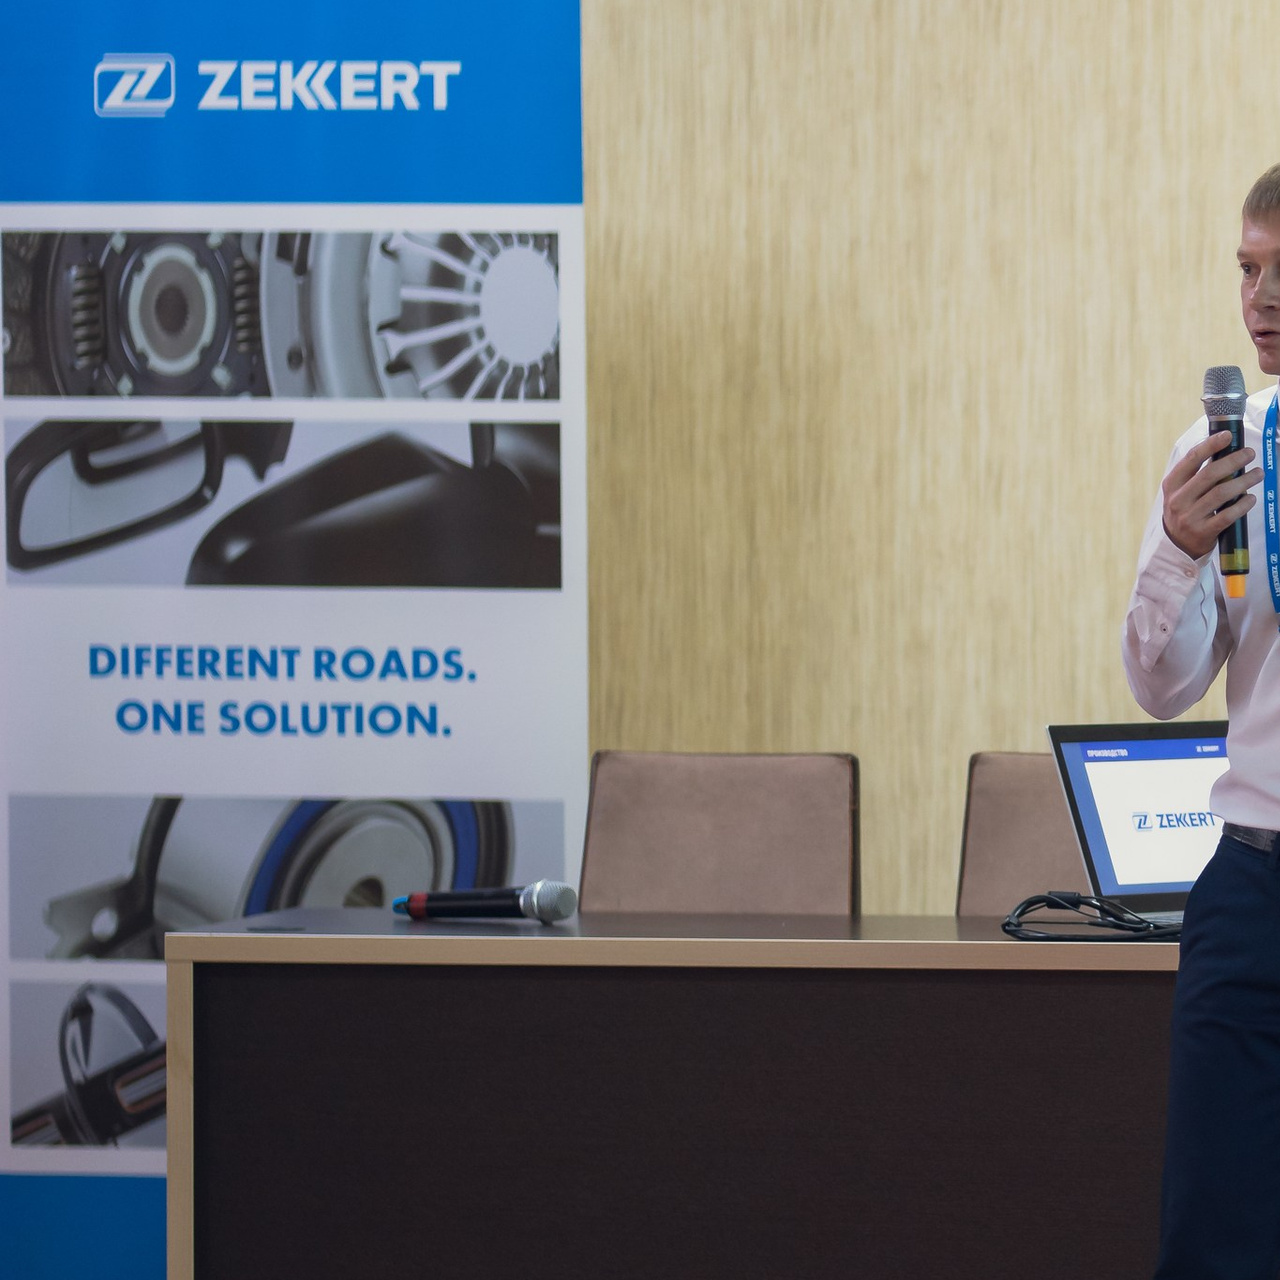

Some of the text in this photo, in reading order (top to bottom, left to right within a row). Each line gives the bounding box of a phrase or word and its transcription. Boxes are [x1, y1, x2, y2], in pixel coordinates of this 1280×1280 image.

[198, 60, 461, 111] ZEKKERT
[89, 644, 477, 682] DIFFERENT ROADS.
[115, 699, 452, 738] ONE SOLUTION.
[1156, 812, 1216, 828] ZEKKERT
